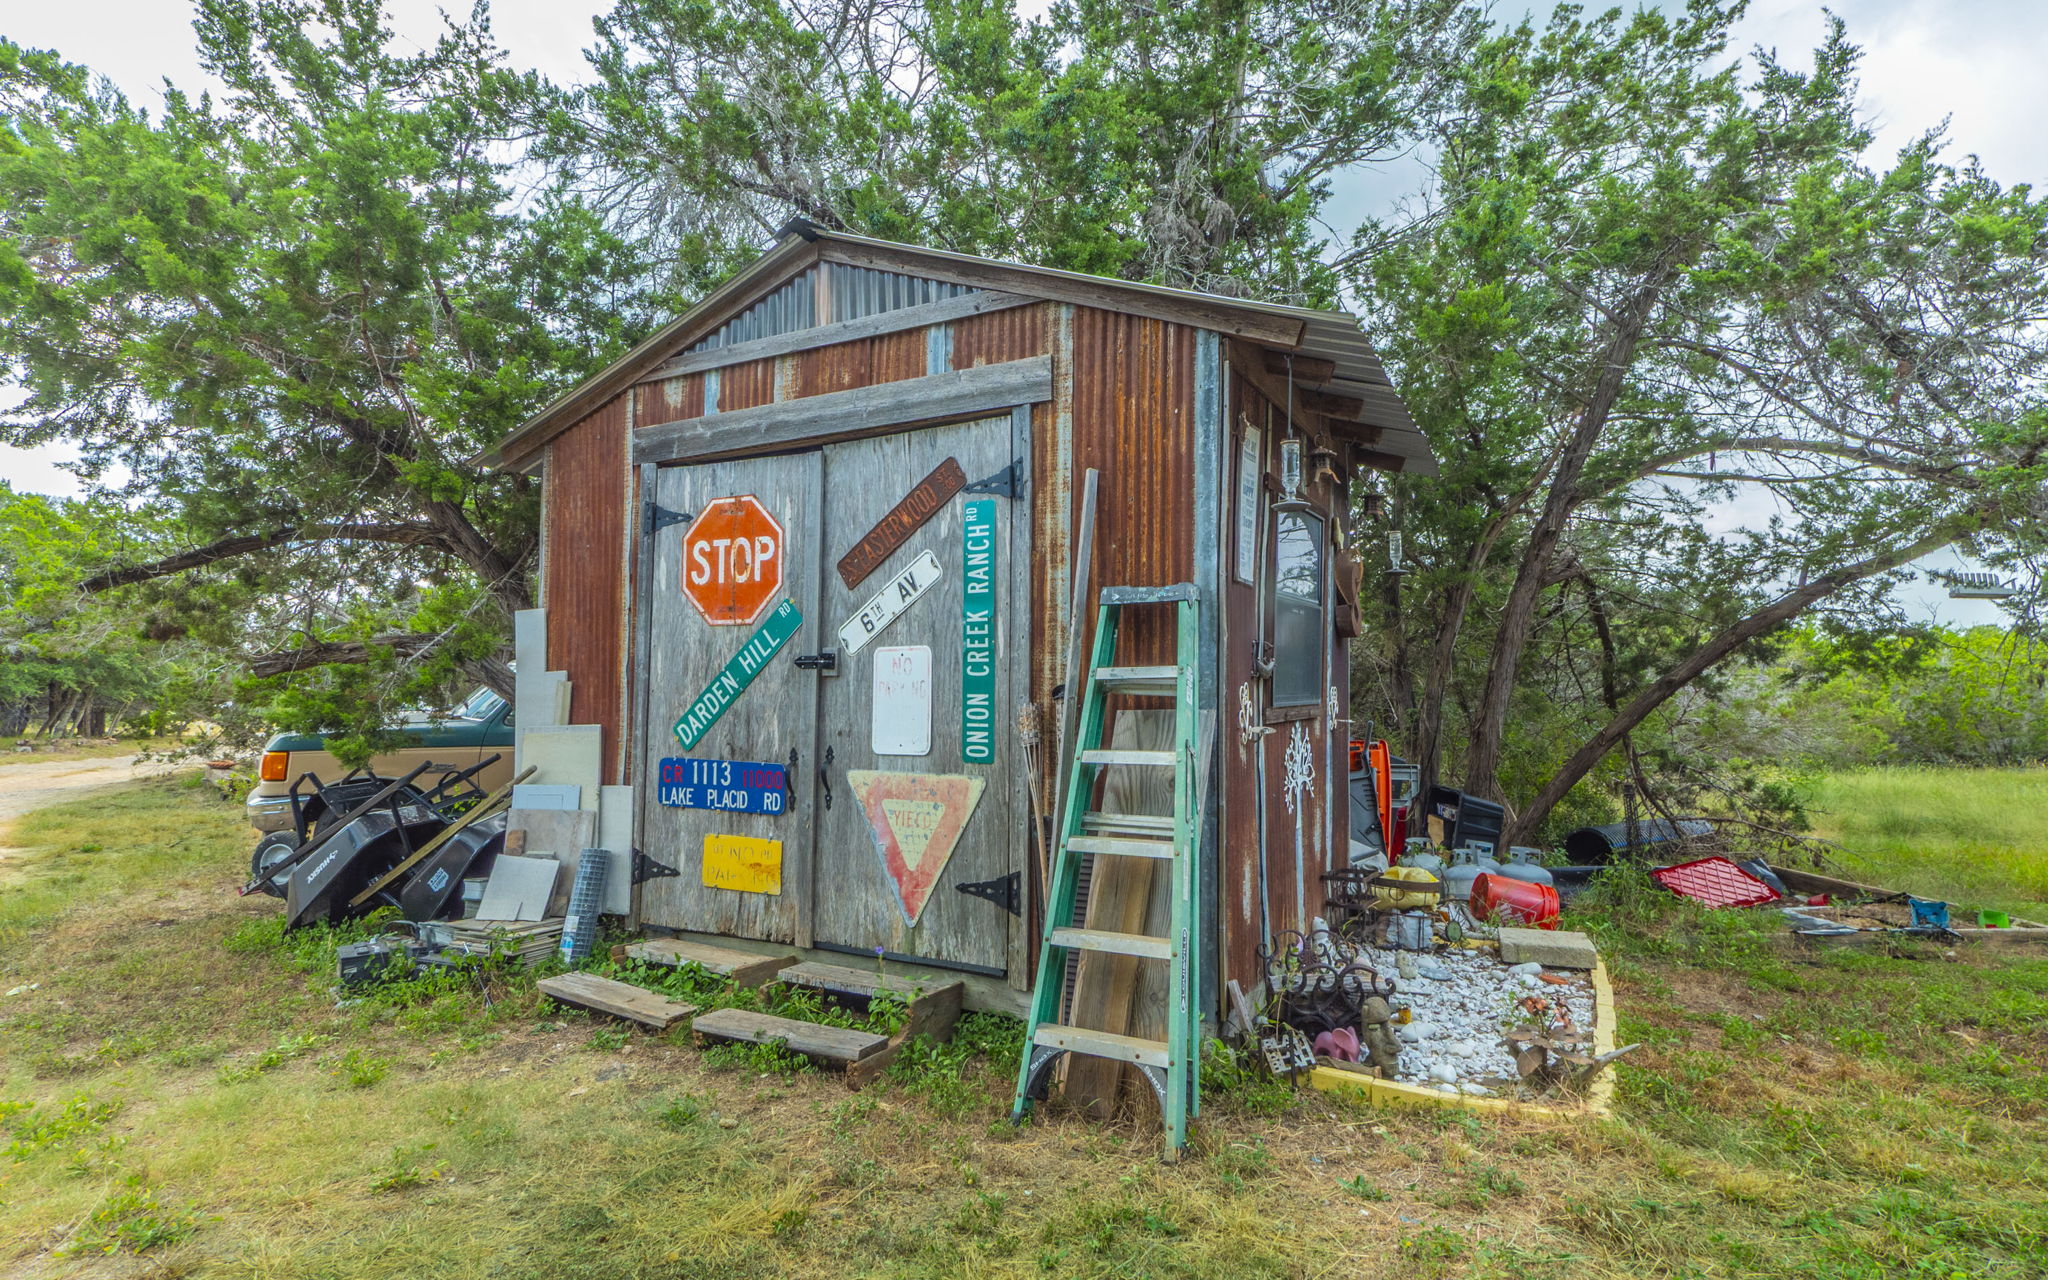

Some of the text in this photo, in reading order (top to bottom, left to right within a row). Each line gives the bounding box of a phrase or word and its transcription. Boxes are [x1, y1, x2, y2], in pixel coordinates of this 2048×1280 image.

[855, 484, 938, 569] EASTERWOOD
[691, 536, 775, 585] STOP
[861, 601, 885, 633] 6TH
[966, 507, 990, 758] ONION CREEK RANCH RD
[677, 602, 791, 745] DARDEN HILL RD
[892, 657, 912, 676] NO
[663, 761, 783, 790] CR 1113 11000
[662, 787, 781, 811] LAKE PLACID RD
[1030, 1050, 1053, 1071] SHOX
[1144, 1065, 1167, 1096] SHOX
